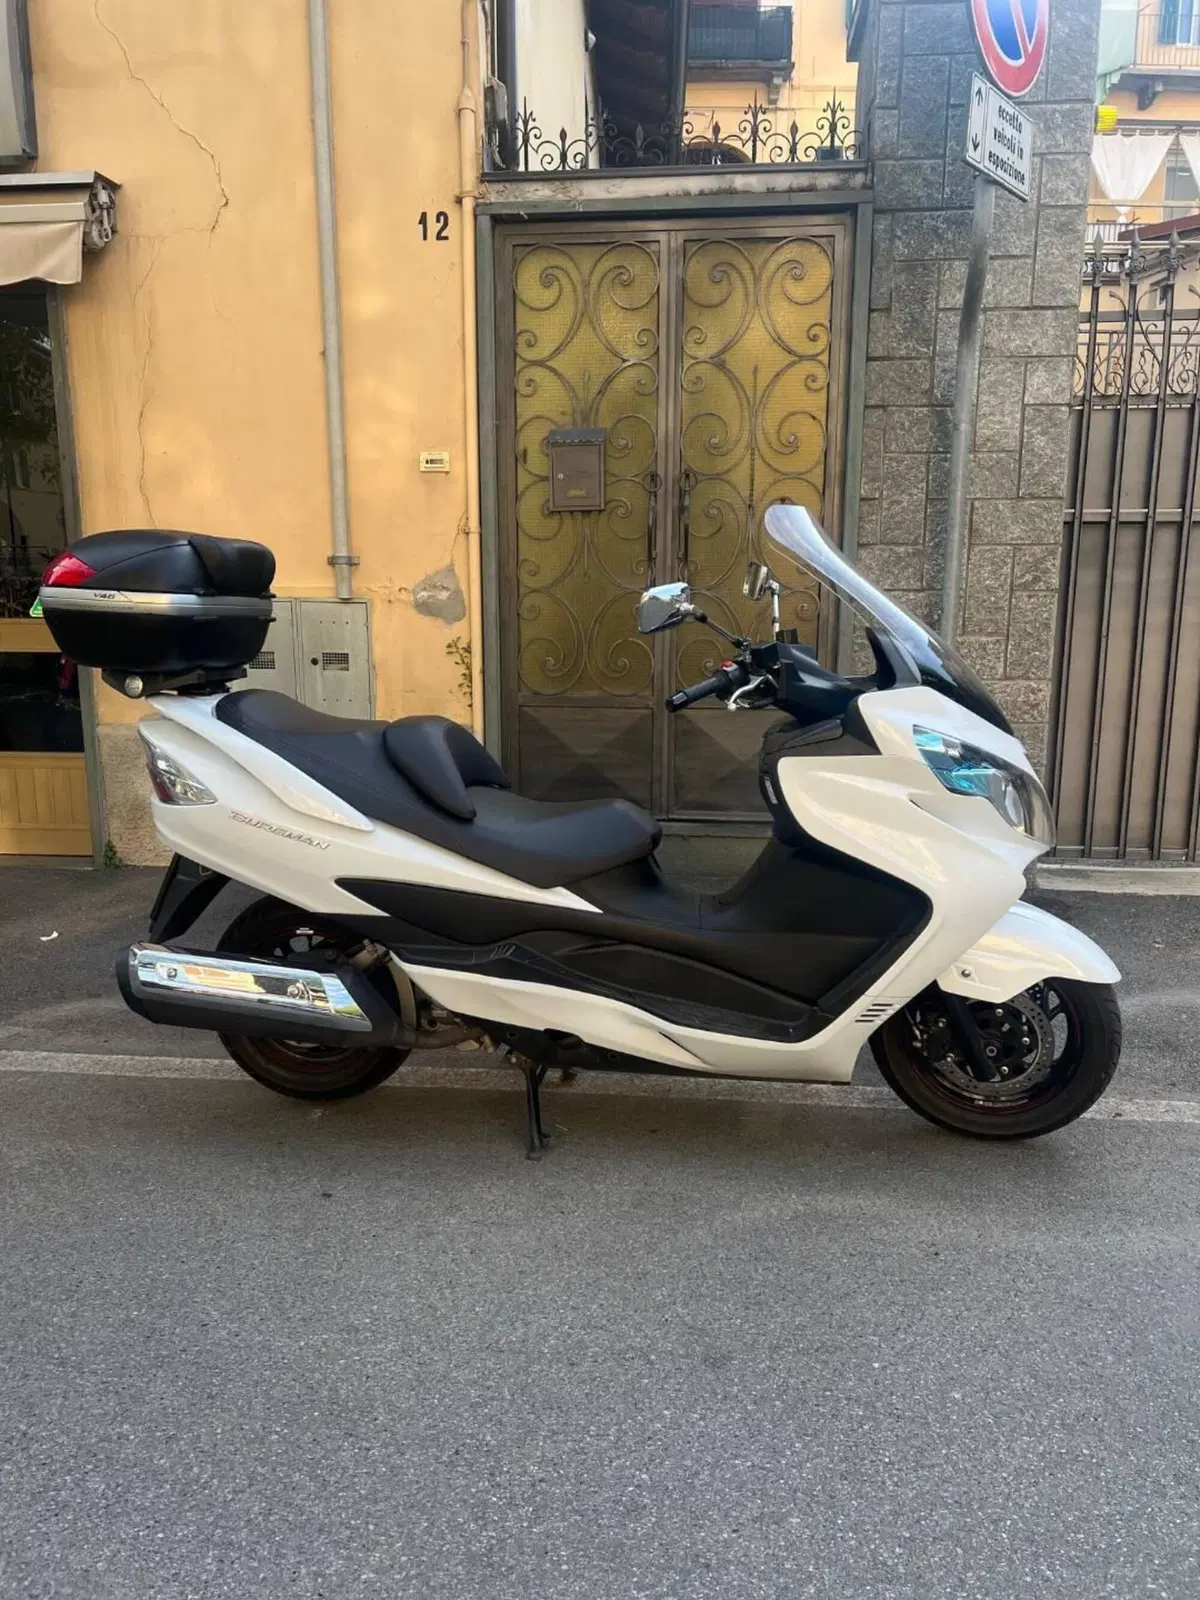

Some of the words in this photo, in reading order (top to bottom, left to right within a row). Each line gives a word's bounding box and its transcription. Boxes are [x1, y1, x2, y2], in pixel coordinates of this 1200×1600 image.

[998, 104, 1023, 134] eccetto
[993, 126, 1016, 154] veicoli
[1017, 140, 1024, 160] in
[988, 150, 1025, 185] esposizione
[418, 211, 449, 241] 12
[228, 810, 331, 850] BURGMAN
